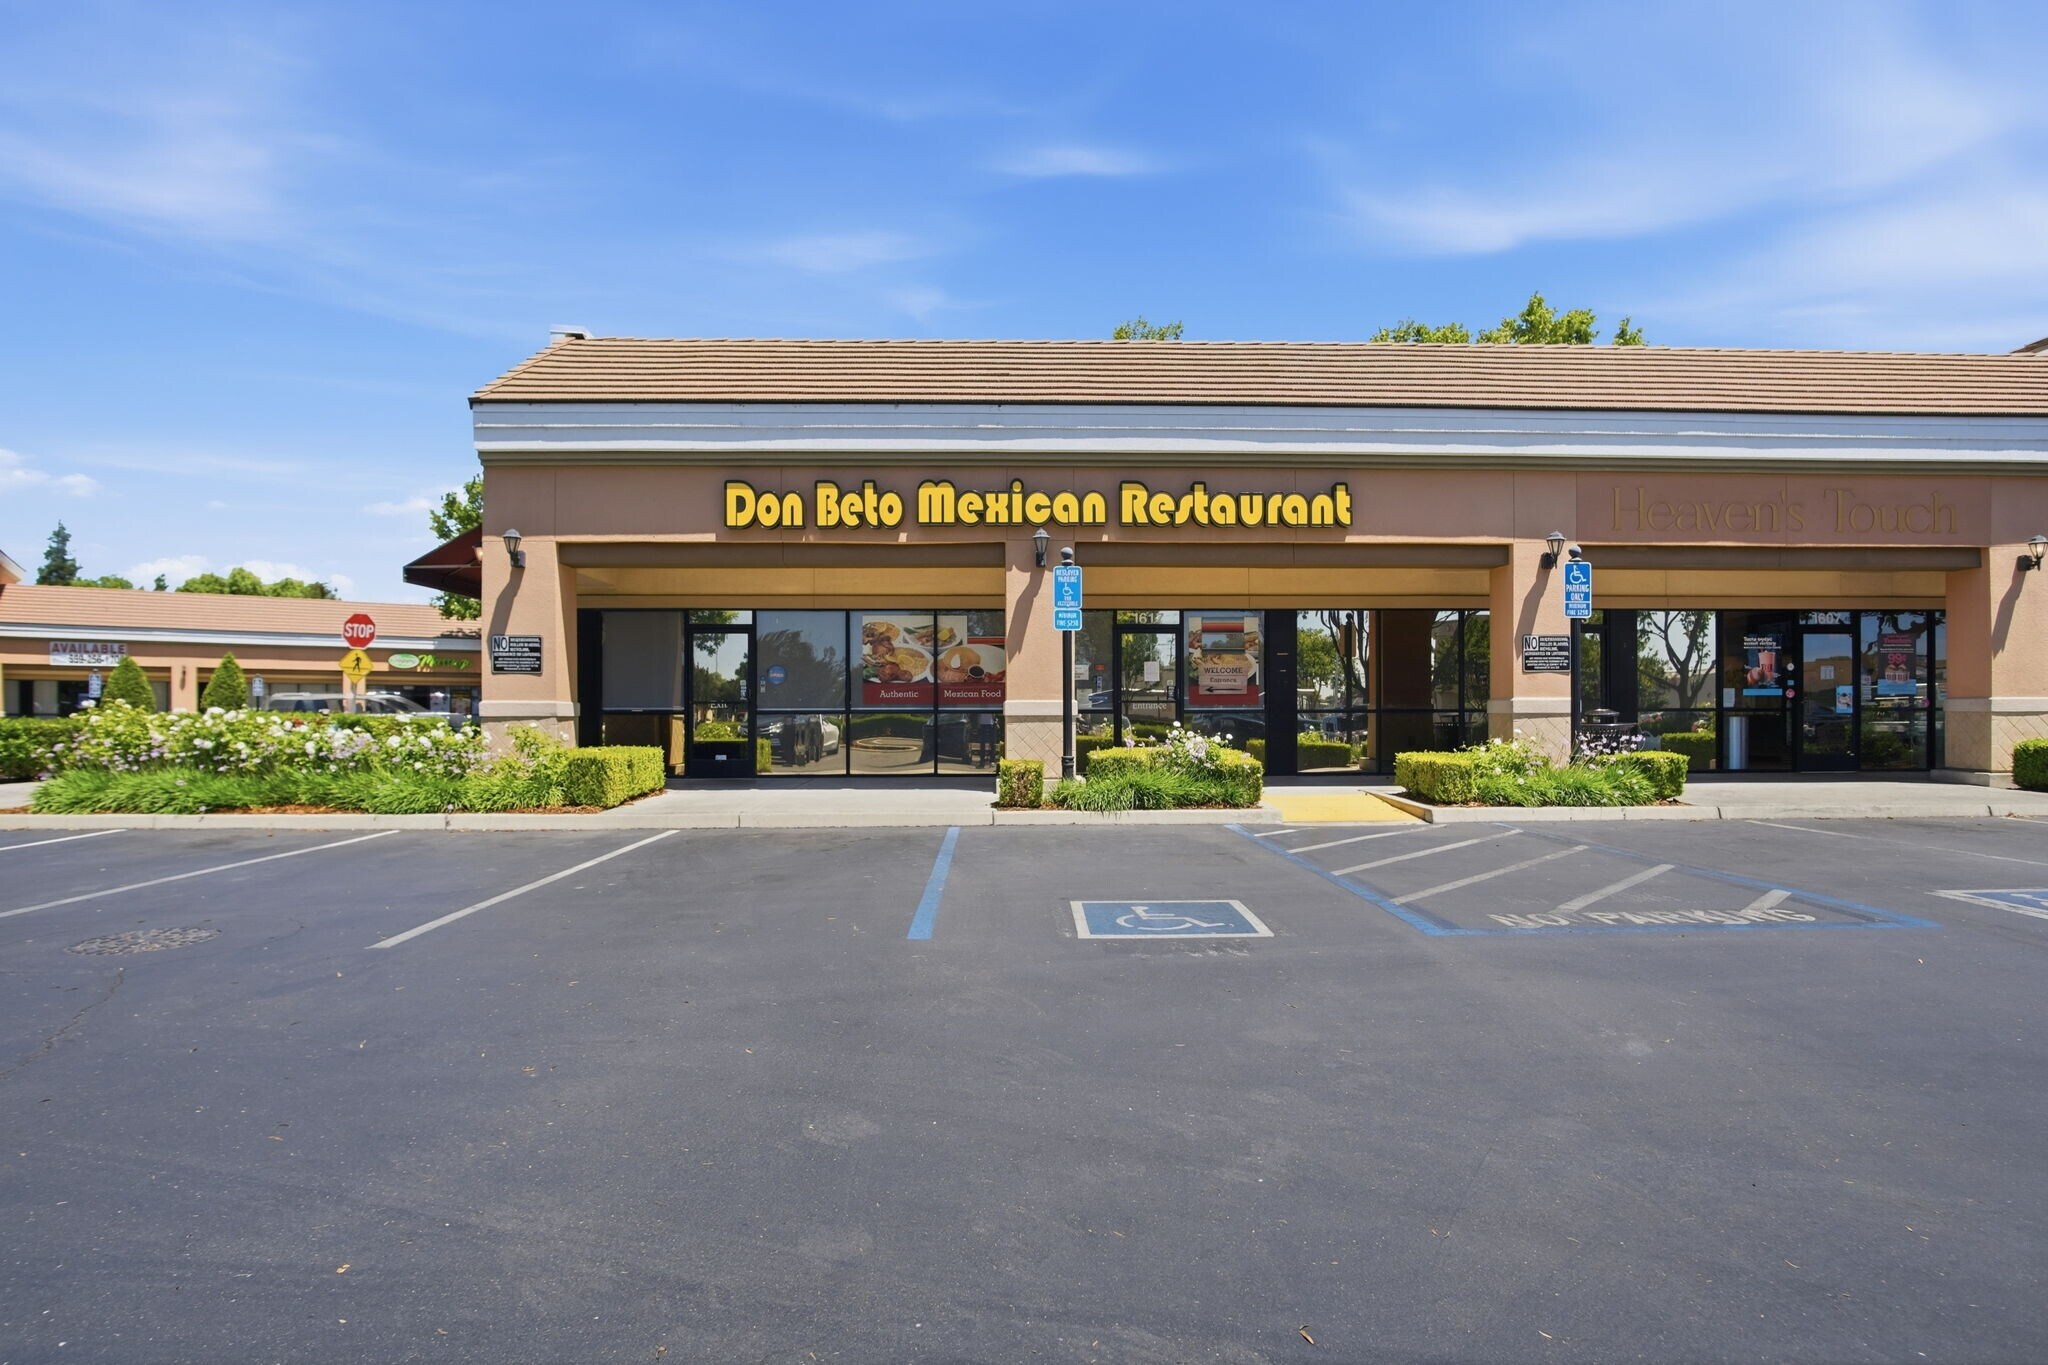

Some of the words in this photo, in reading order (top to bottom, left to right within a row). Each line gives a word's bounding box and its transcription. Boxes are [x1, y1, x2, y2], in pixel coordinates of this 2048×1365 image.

[725, 480, 805, 528] Don
[815, 480, 904, 528] Beto
[917, 478, 1107, 527] Mexican
[1119, 480, 1352, 528] Restaurant
[1611, 487, 1804, 532] Heaven's
[1823, 487, 1960, 535] Touch
[1566, 584, 1589, 592] PARKING
[344, 623, 374, 638] STOP
[52, 643, 126, 654] AVAILABLE
[493, 637, 508, 650] NO
[1524, 637, 1538, 650] NO
[880, 690, 918, 698] Authentic
[943, 690, 979, 698] Mexican
[981, 690, 1001, 698] Food
[1487, 913, 1570, 928] NO
[1582, 909, 1816, 925] PARKING
